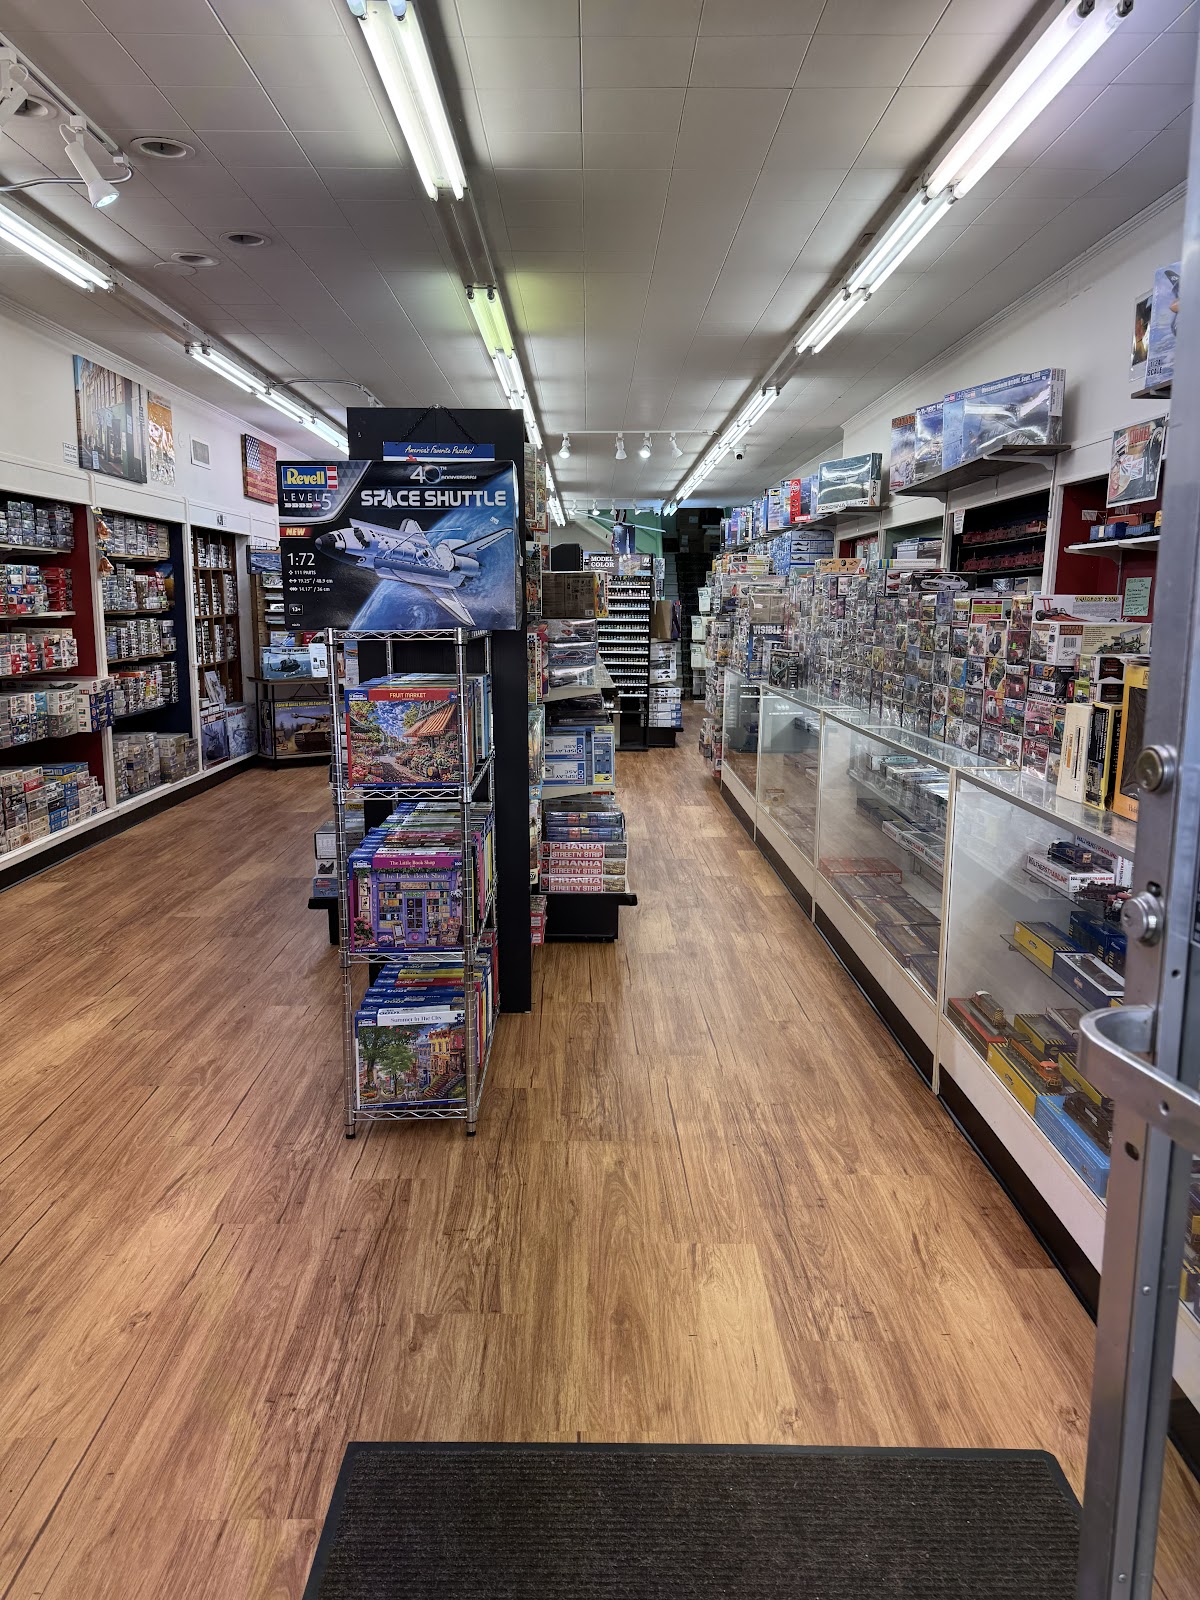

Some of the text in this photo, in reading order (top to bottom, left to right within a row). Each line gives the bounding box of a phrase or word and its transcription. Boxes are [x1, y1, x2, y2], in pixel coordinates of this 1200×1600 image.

[1147, 366, 1162, 377] SCALE
[404, 444, 475, 455] America's Favorite Puzzles!
[287, 468, 325, 485] Revell
[283, 493, 332, 511] LEVEL 5
[361, 488, 507, 508] SPACE SHUTTLE
[286, 528, 306, 536] NEW
[287, 552, 316, 566] 1:72
[753, 625, 782, 635] VISIBLE
